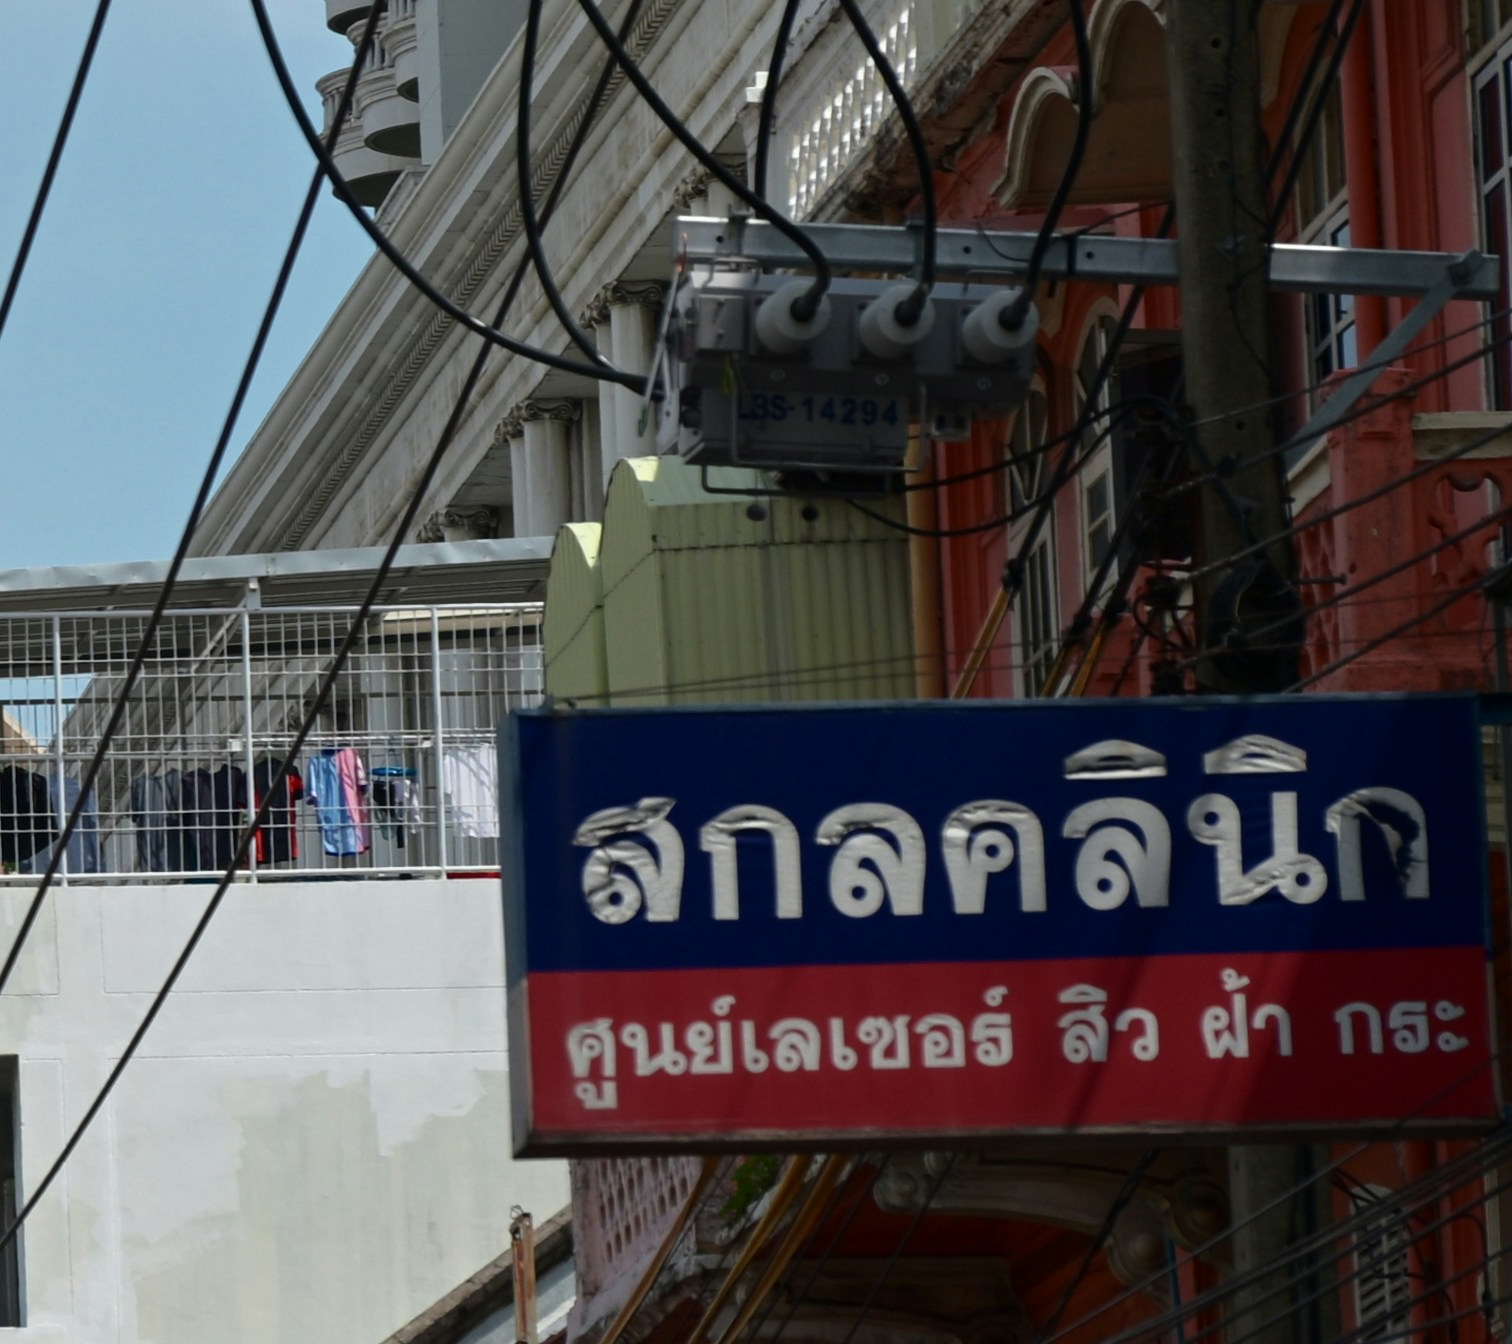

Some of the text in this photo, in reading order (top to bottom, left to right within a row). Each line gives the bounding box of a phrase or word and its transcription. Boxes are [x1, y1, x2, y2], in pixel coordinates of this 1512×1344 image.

[571, 733, 1431, 926] สกลคลินิก
[566, 968, 1467, 1110] ศูนย์เลเซอร์ สิว ฝ้า กระ
